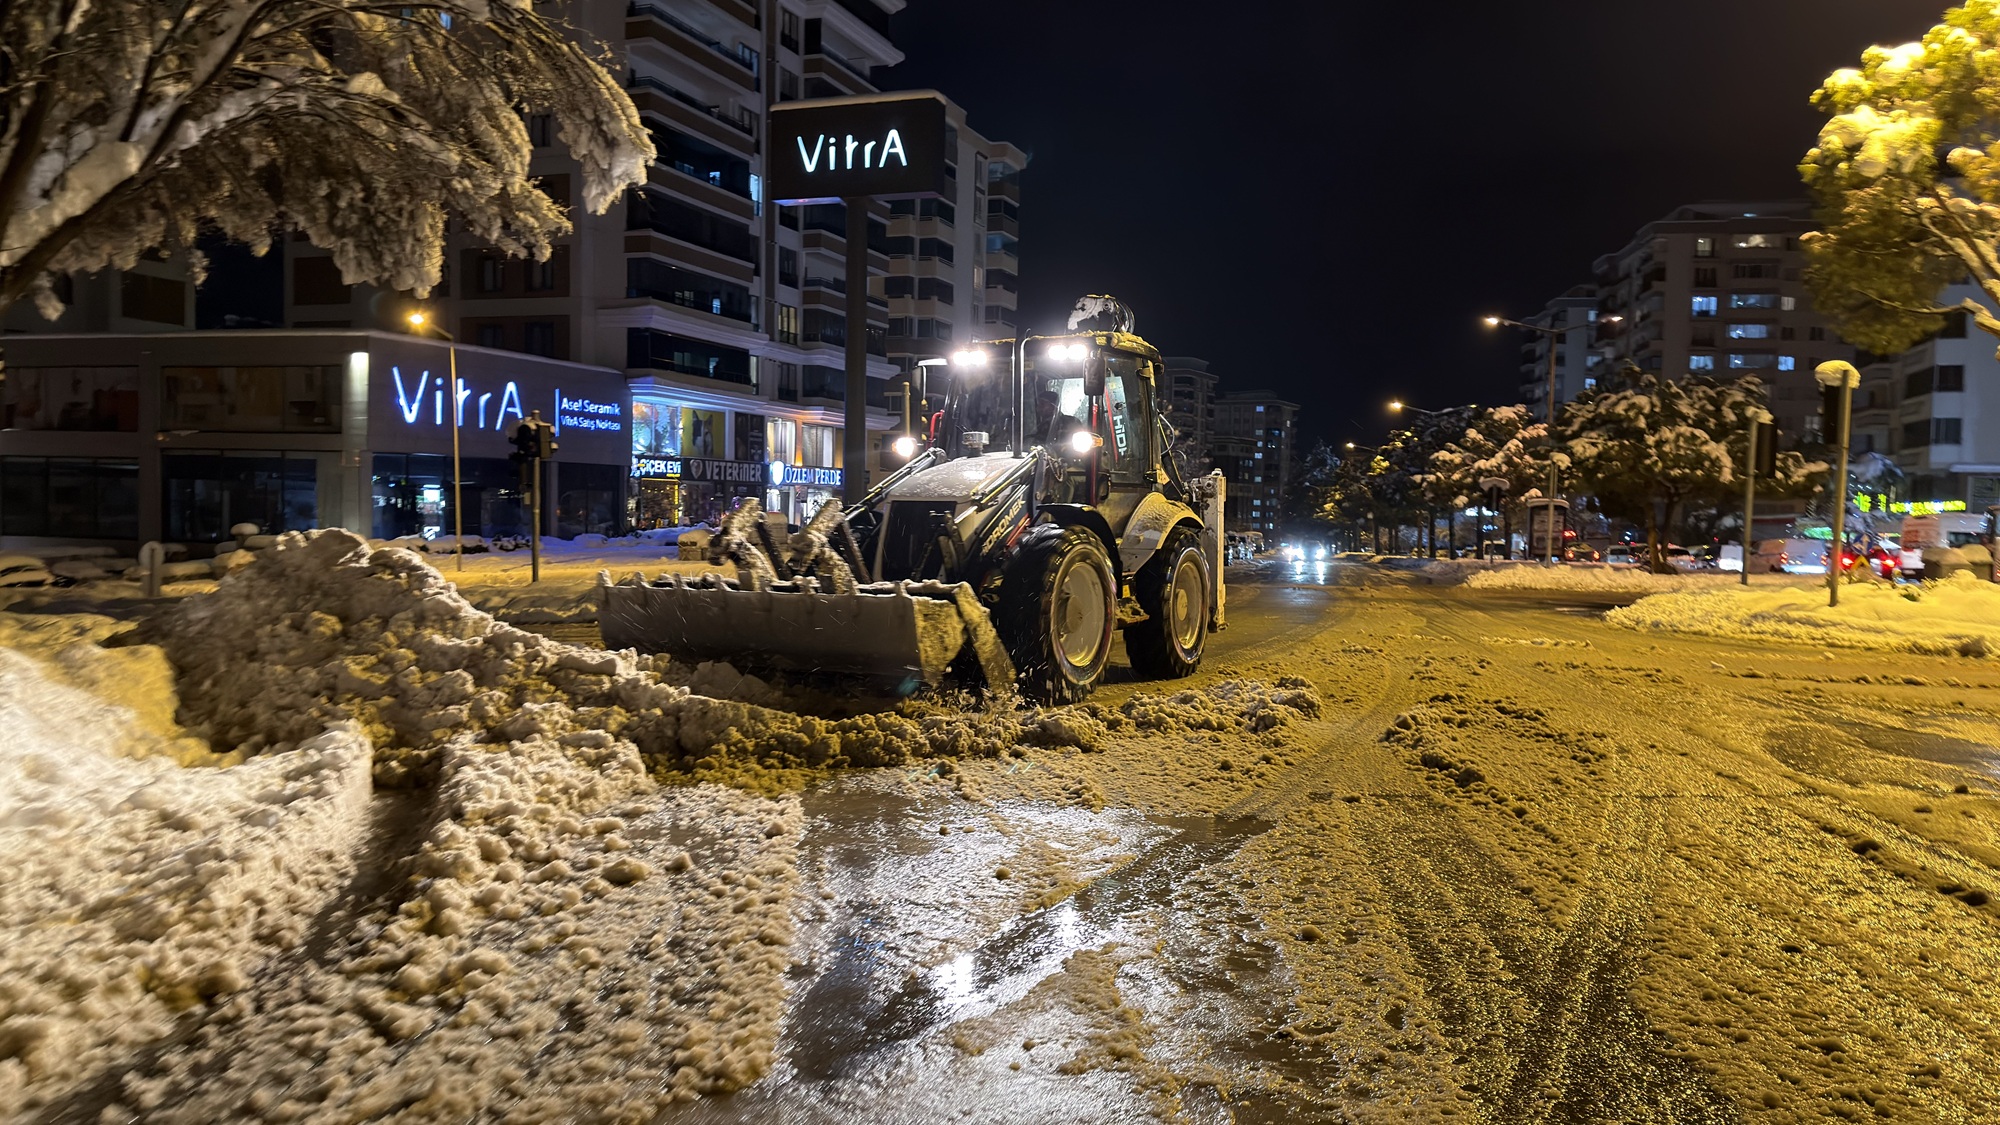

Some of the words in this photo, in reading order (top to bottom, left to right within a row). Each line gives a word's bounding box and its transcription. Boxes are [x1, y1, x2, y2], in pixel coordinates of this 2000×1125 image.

[796, 128, 908, 173] VitrA
[392, 366, 523, 431] VitrA
[560, 397, 583, 411] Asel
[583, 400, 621, 415] Seramik
[560, 415, 579, 426] VitrA
[784, 464, 814, 484] ÖZLEM
[814, 468, 842, 486] PERDE
